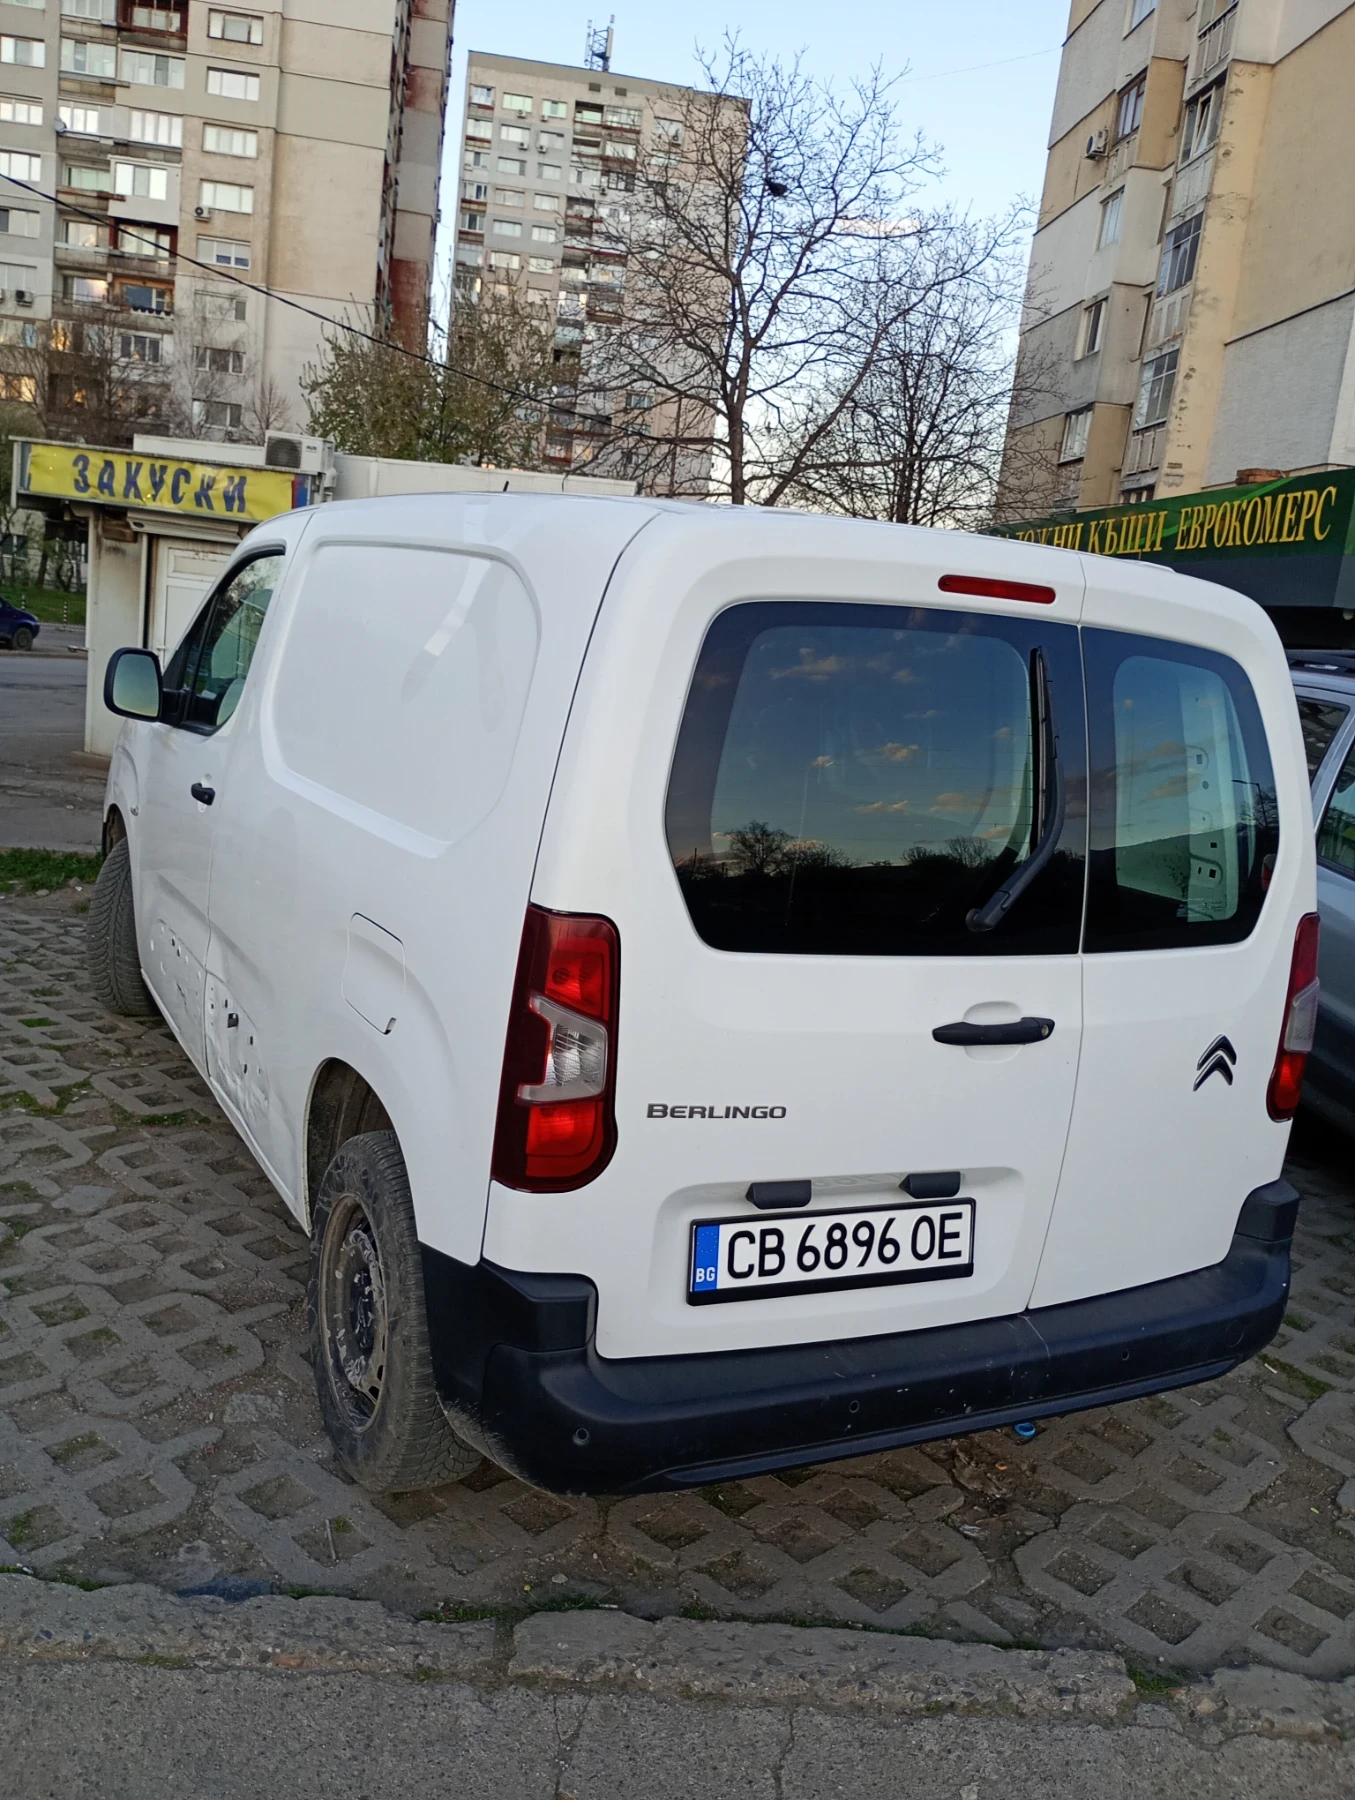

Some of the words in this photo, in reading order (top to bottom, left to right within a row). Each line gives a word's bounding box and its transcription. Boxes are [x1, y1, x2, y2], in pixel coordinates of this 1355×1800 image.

[72, 454, 247, 513] ЗАКУСКИ
[1087, 510, 1168, 560] КЪЩИ
[1175, 486, 1337, 551] ЕВРОКОМЕРС
[695, 1266, 716, 1283] BG
[727, 1227, 785, 1279] CB
[796, 1217, 901, 1273] 6896
